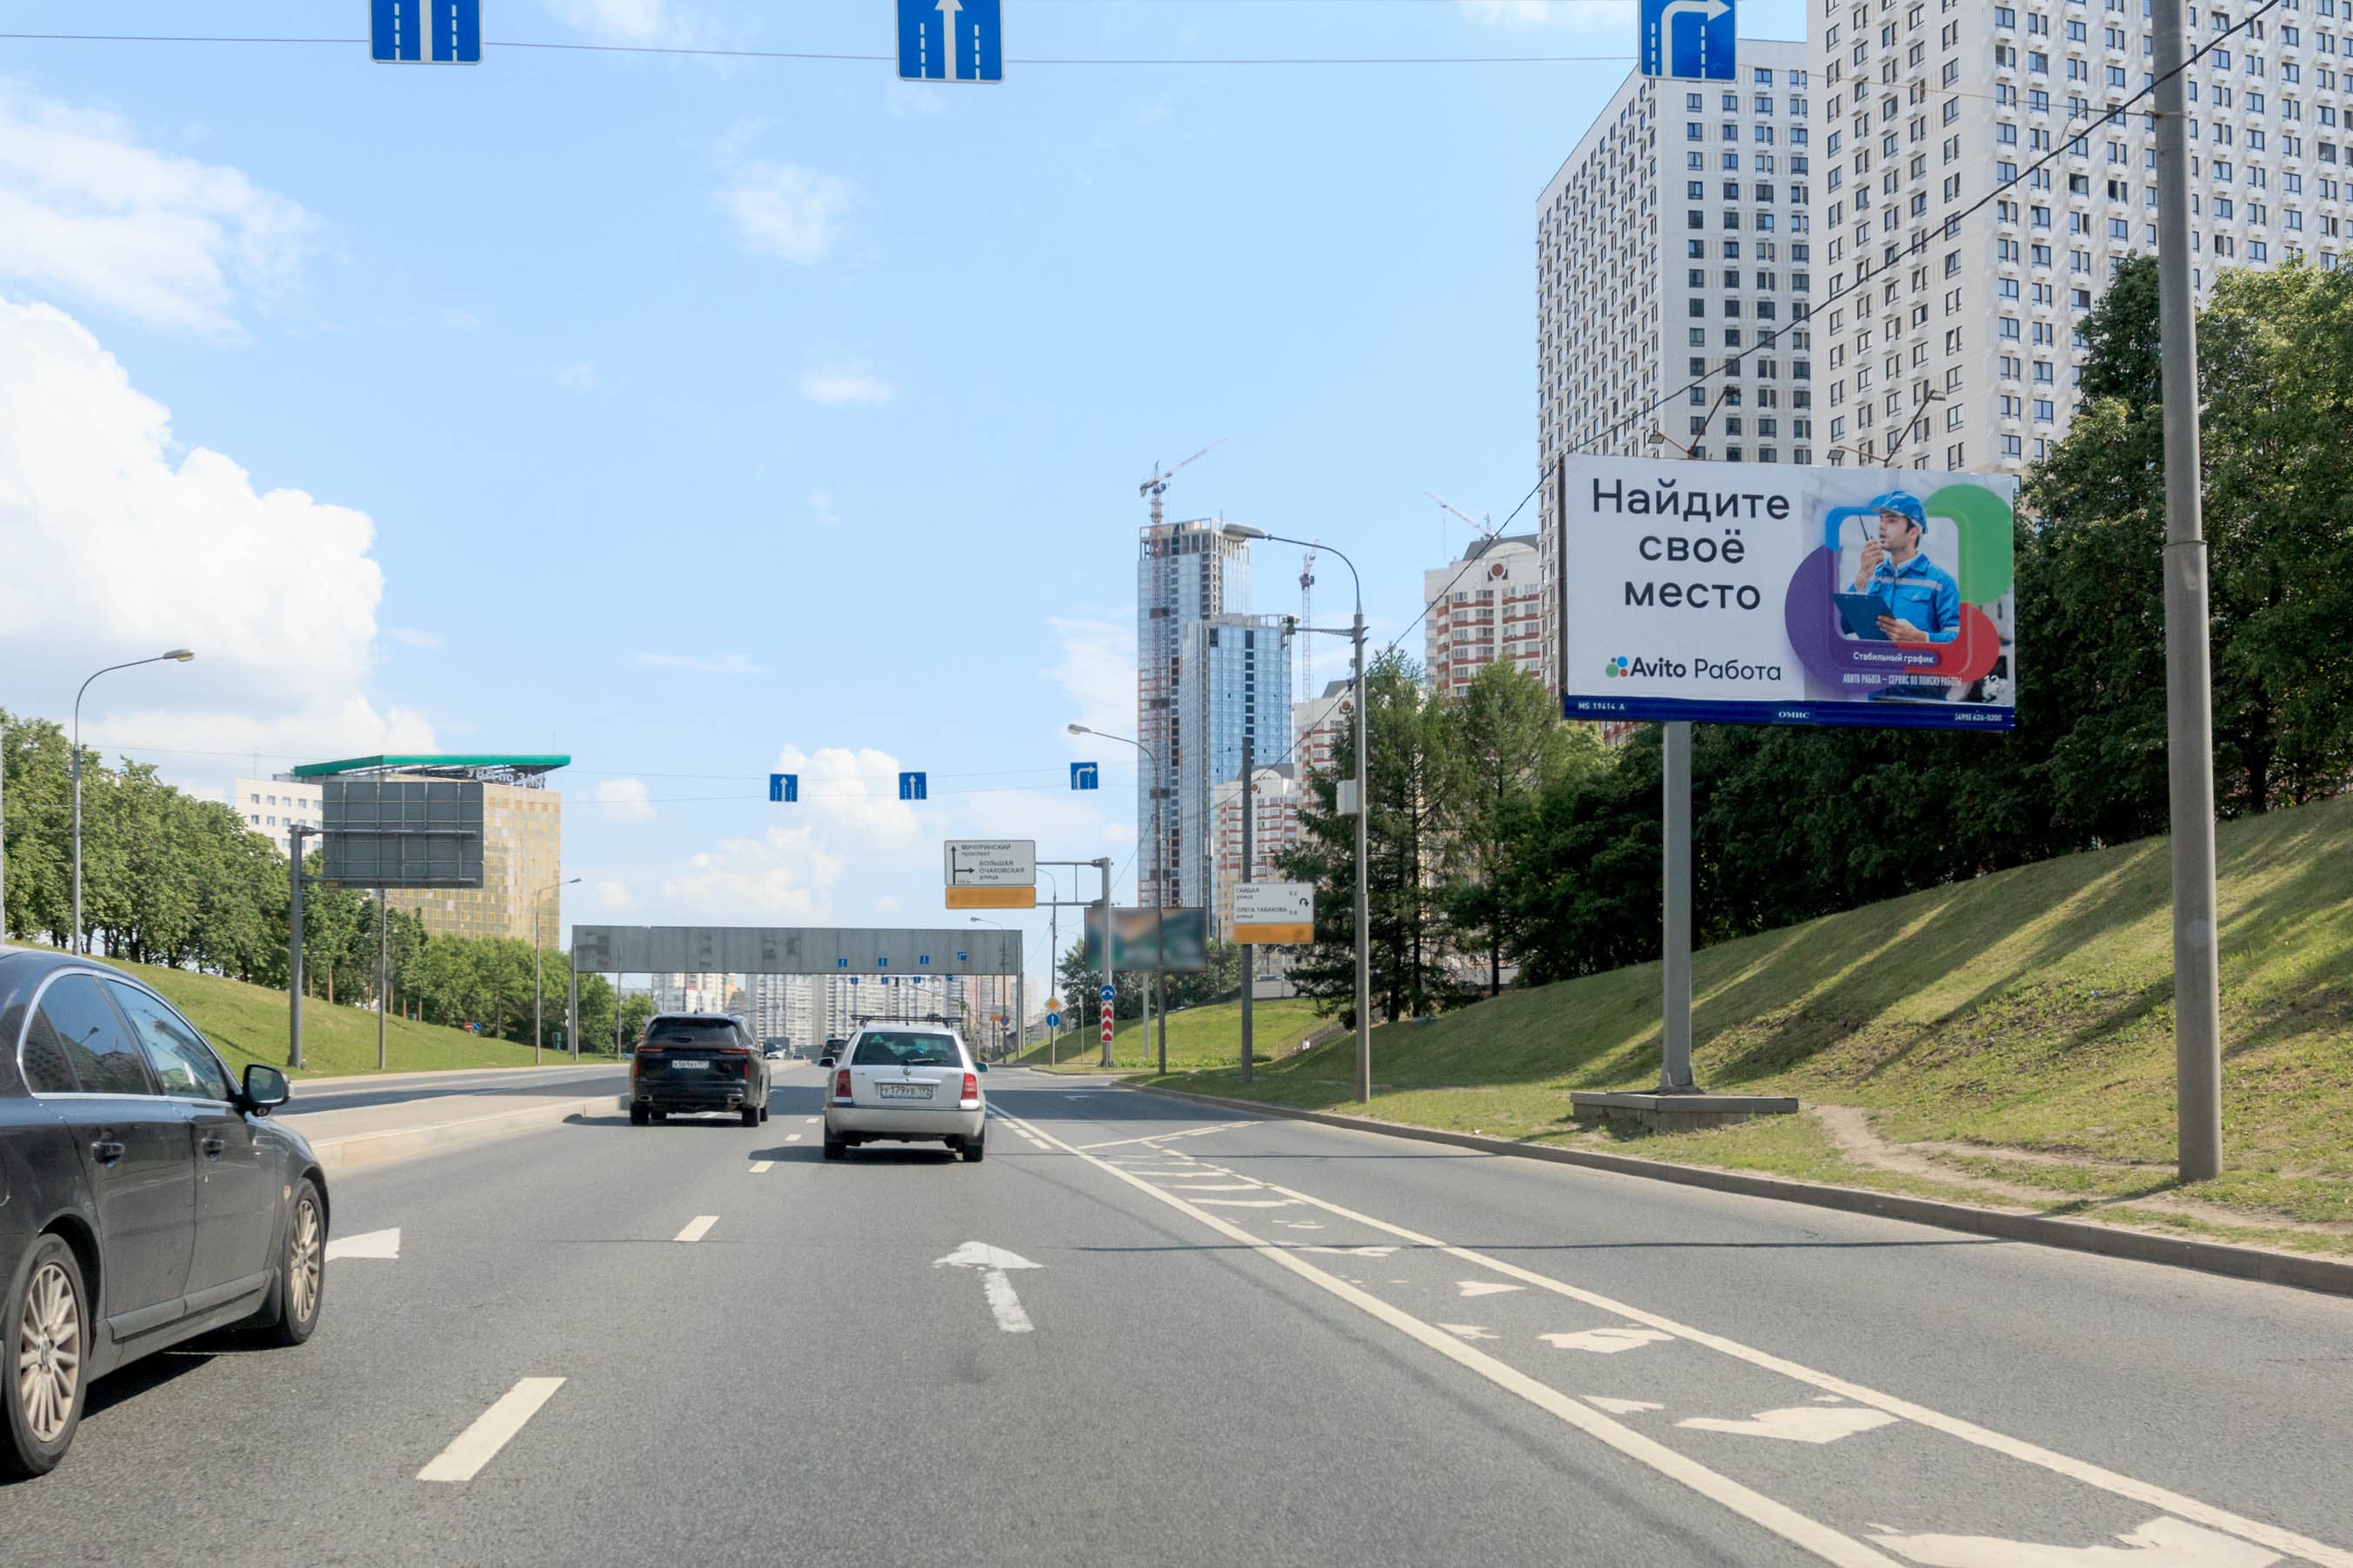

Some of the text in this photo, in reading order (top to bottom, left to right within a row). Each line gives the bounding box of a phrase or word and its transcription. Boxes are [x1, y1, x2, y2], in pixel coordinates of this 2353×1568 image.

[1593, 477, 1790, 523] Найдите
[1639, 529, 1745, 564] своё
[1625, 580, 1761, 611] место
[1629, 657, 1781, 681] Avito Работа
[1853, 651, 1935, 665] Стабильный график
[1843, 674, 1861, 684] АВИТО
[1861, 674, 1882, 684] РАБОТА
[1888, 675, 1909, 685] СЕРВИС
[1909, 675, 1918, 685] ПО
[1919, 675, 1941, 686] ПОИСКУ
[1941, 676, 1962, 686] РАБОТЫ
